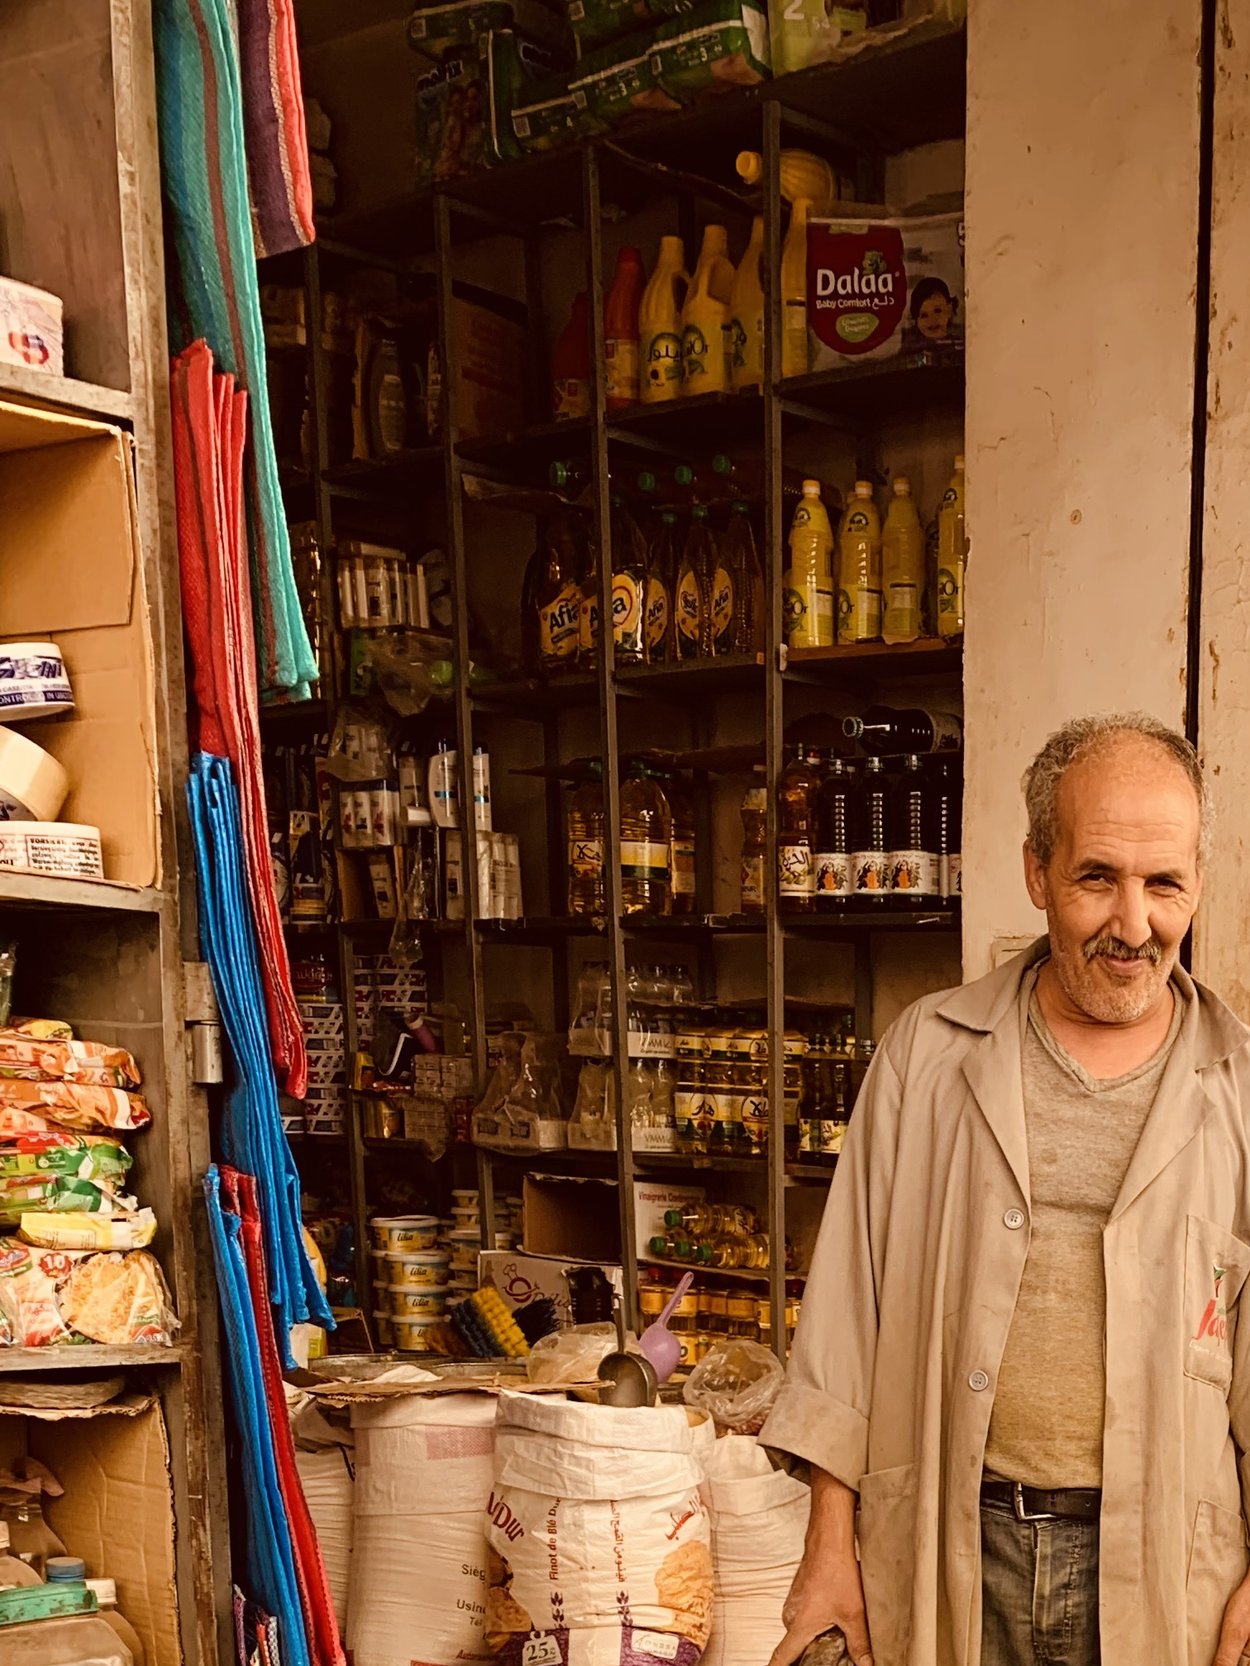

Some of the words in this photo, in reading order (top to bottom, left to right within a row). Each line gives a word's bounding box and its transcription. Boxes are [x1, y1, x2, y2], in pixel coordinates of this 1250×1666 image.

[816, 267, 893, 296] Dalaa
[816, 299, 836, 310] Baby
[837, 298, 871, 309] Comfort
[461, 1564, 486, 1581] Sièg
[526, 1641, 549, 1661] 25
